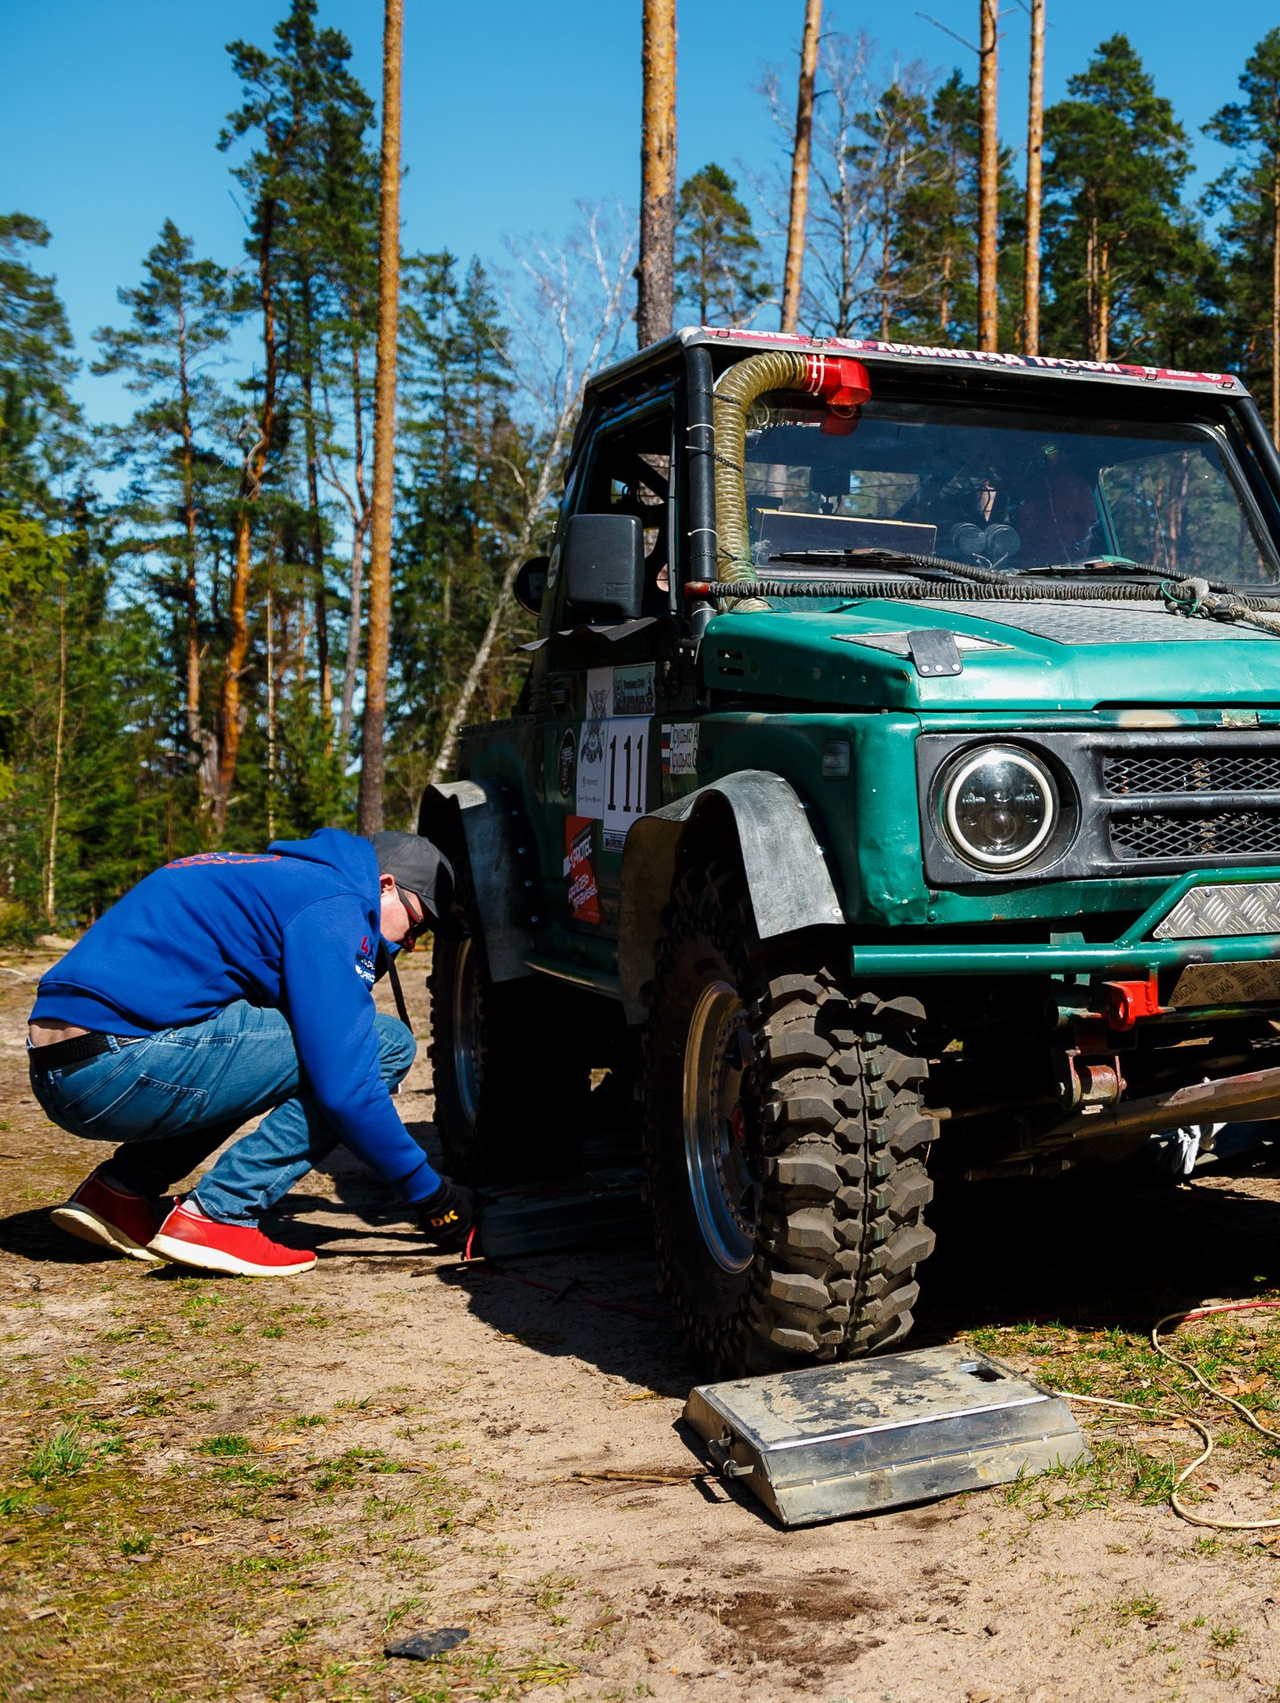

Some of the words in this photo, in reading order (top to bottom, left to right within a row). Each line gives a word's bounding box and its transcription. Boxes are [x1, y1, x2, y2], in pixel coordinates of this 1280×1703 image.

[877, 341, 1027, 367] ЛЕНИНГРАД
[1028, 355, 1122, 373] ТРОФИ
[608, 734, 644, 813] 111
